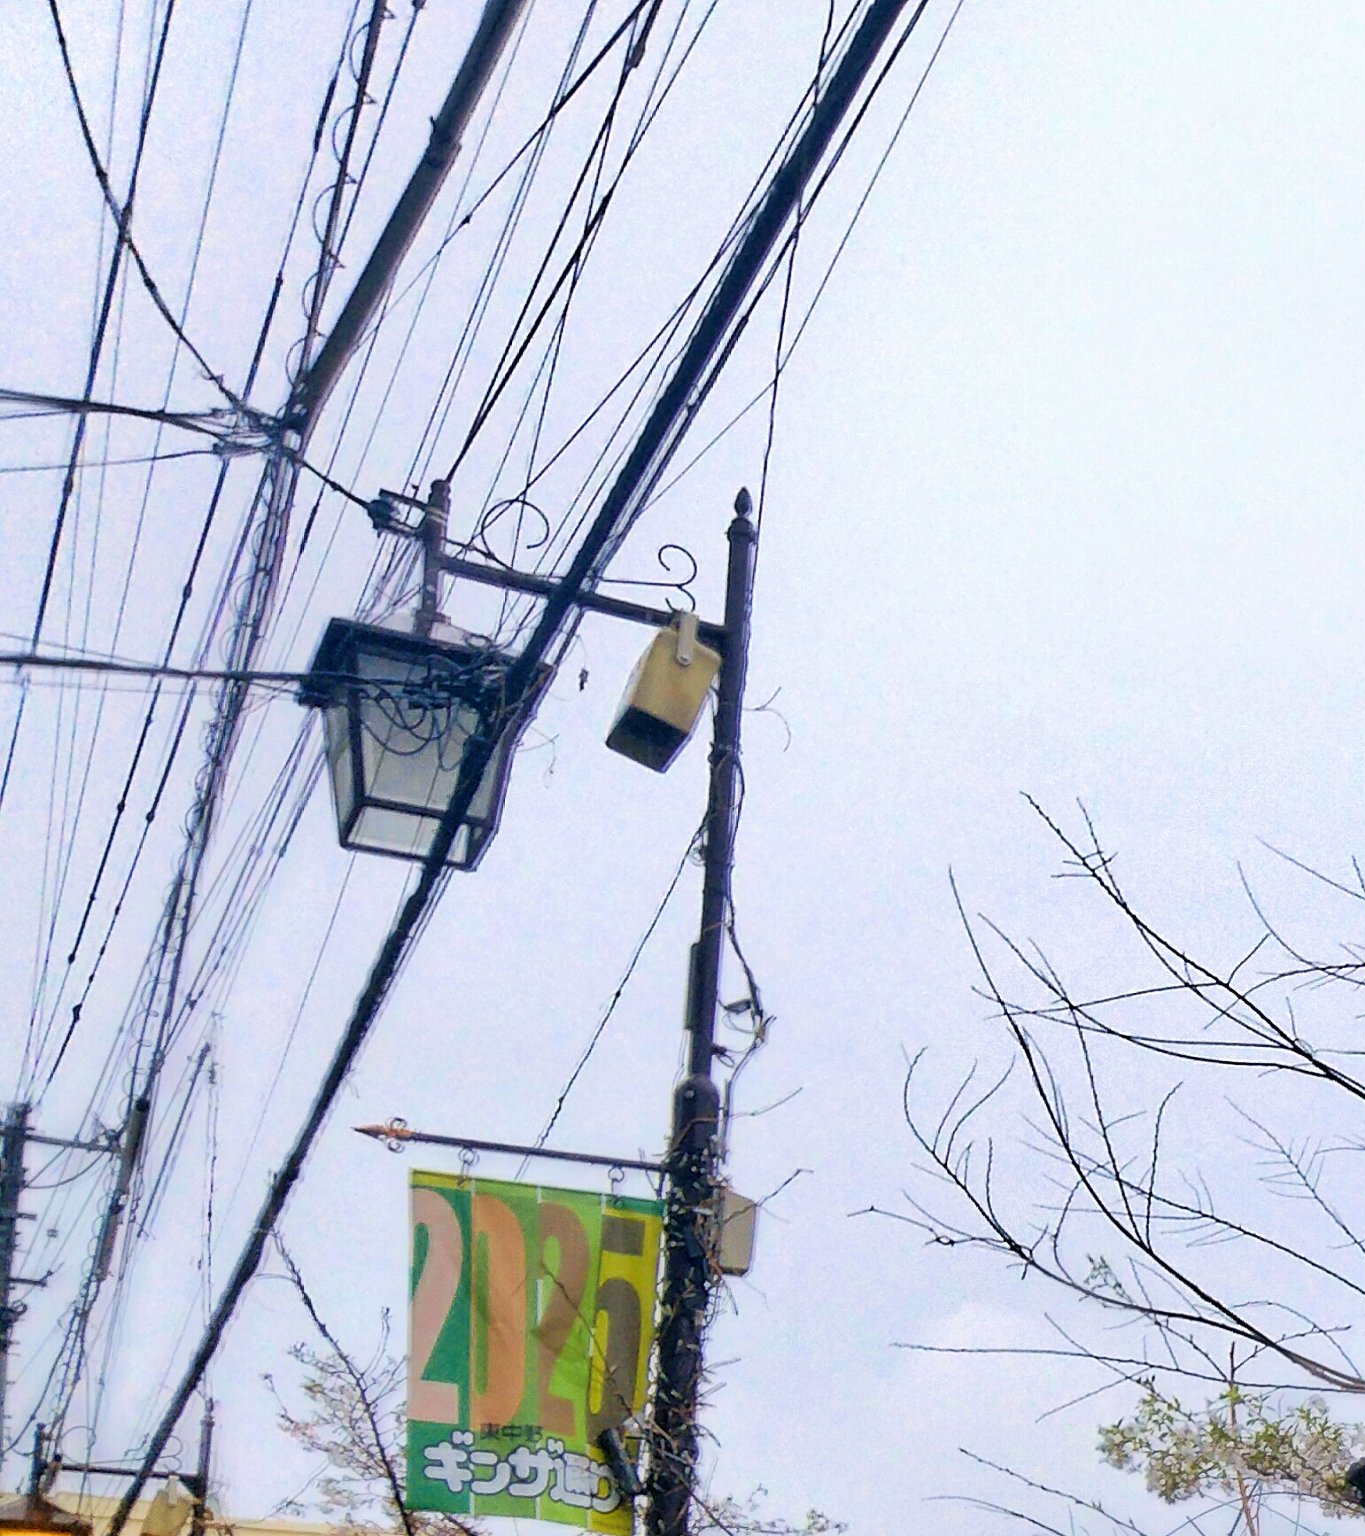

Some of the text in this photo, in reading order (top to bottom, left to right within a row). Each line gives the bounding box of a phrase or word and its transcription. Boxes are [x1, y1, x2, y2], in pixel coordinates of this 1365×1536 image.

[423, 1429, 621, 1513] ギンザ通り
